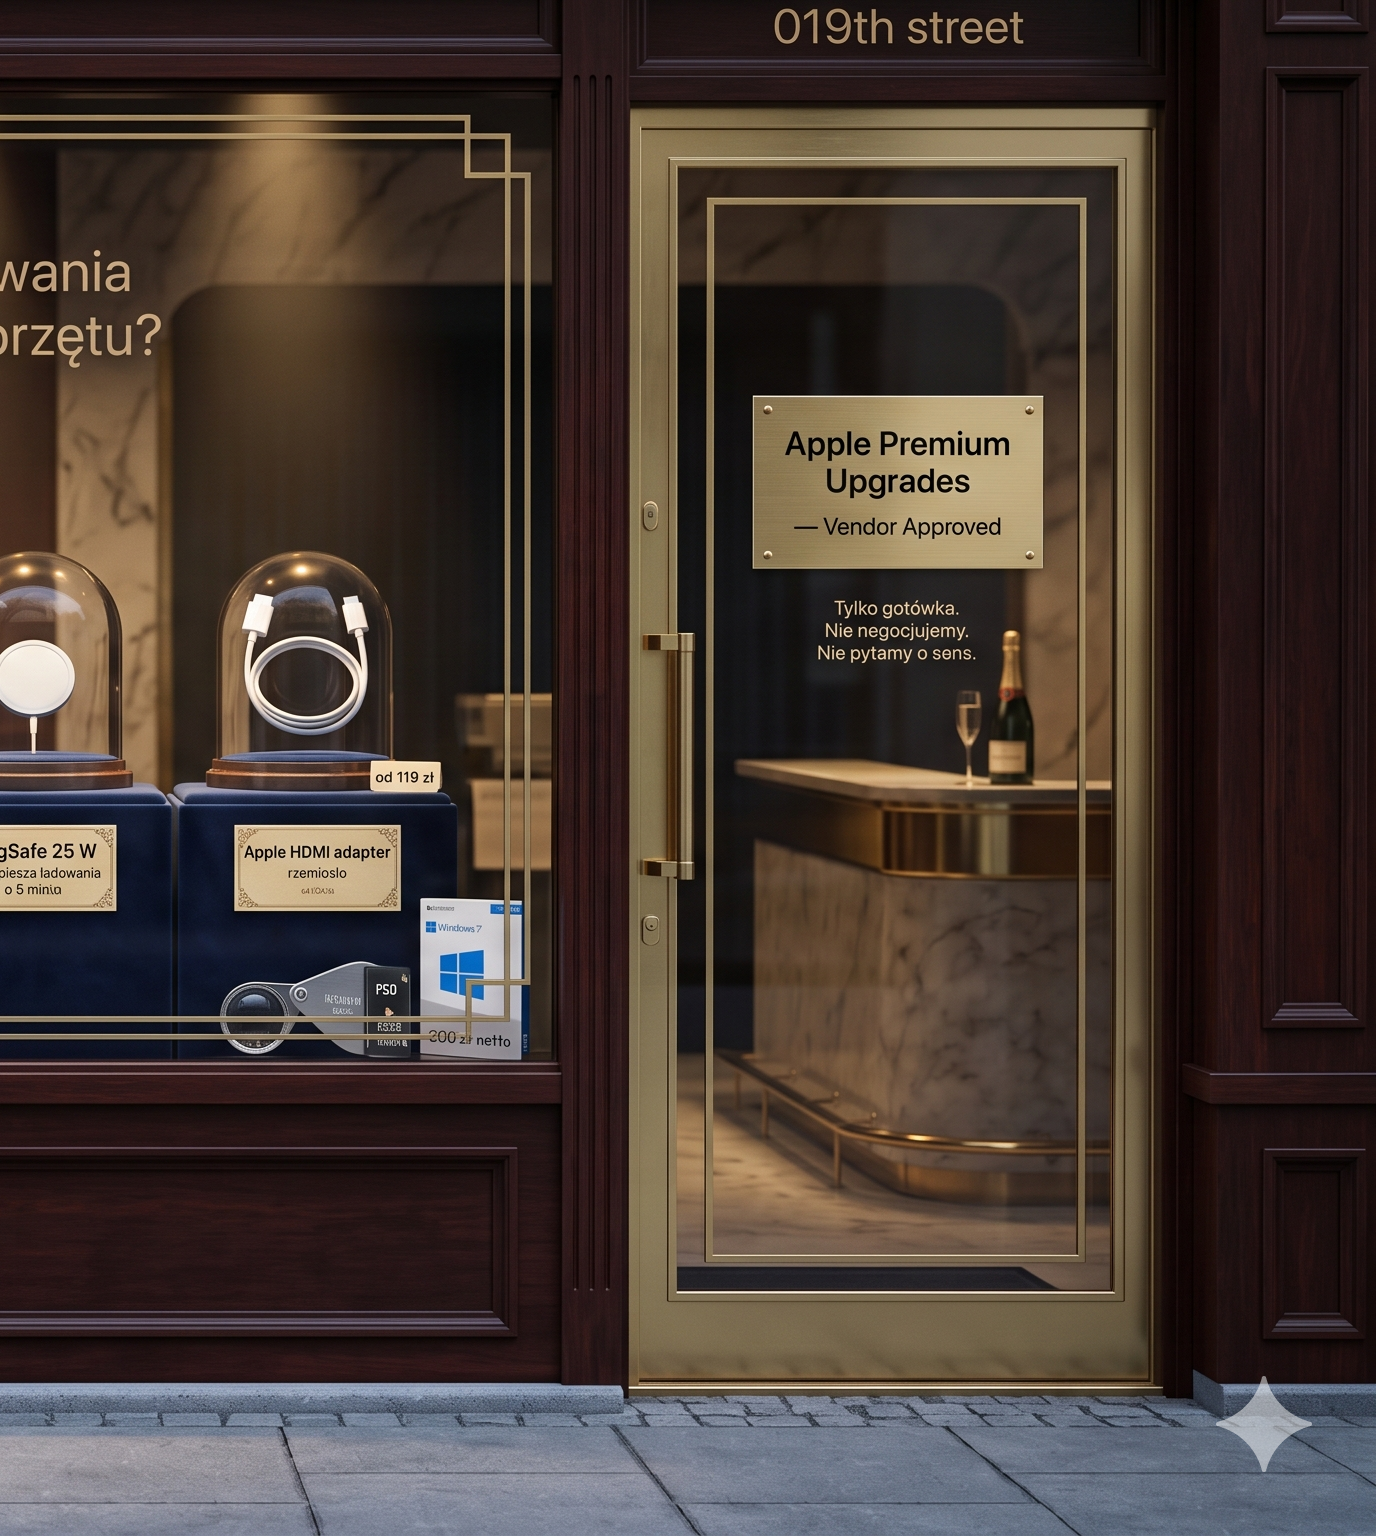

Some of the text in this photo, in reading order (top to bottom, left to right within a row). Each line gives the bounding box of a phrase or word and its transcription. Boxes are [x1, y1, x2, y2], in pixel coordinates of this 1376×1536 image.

[774, 8, 1024, 45] 019th street
[784, 430, 1010, 462] Apple Premium
[826, 468, 970, 500] Upgrades
[822, 517, 898, 536] Vendor
[902, 517, 1001, 540] Approved
[833, 599, 959, 619] Tylko gotówka.
[825, 622, 969, 642] Nie negocjujemy.
[817, 645, 976, 664] Nie pytamy o sens.
[375, 771, 435, 784] od 119 zł
[52, 843, 75, 859] 25
[79, 843, 97, 859] W
[241, 845, 391, 862] Apple HDMI adapter
[4, 886, 13, 895] o
[16, 883, 24, 895] 5
[437, 923, 483, 933] Windows 7
[476, 1034, 511, 1048] netto
